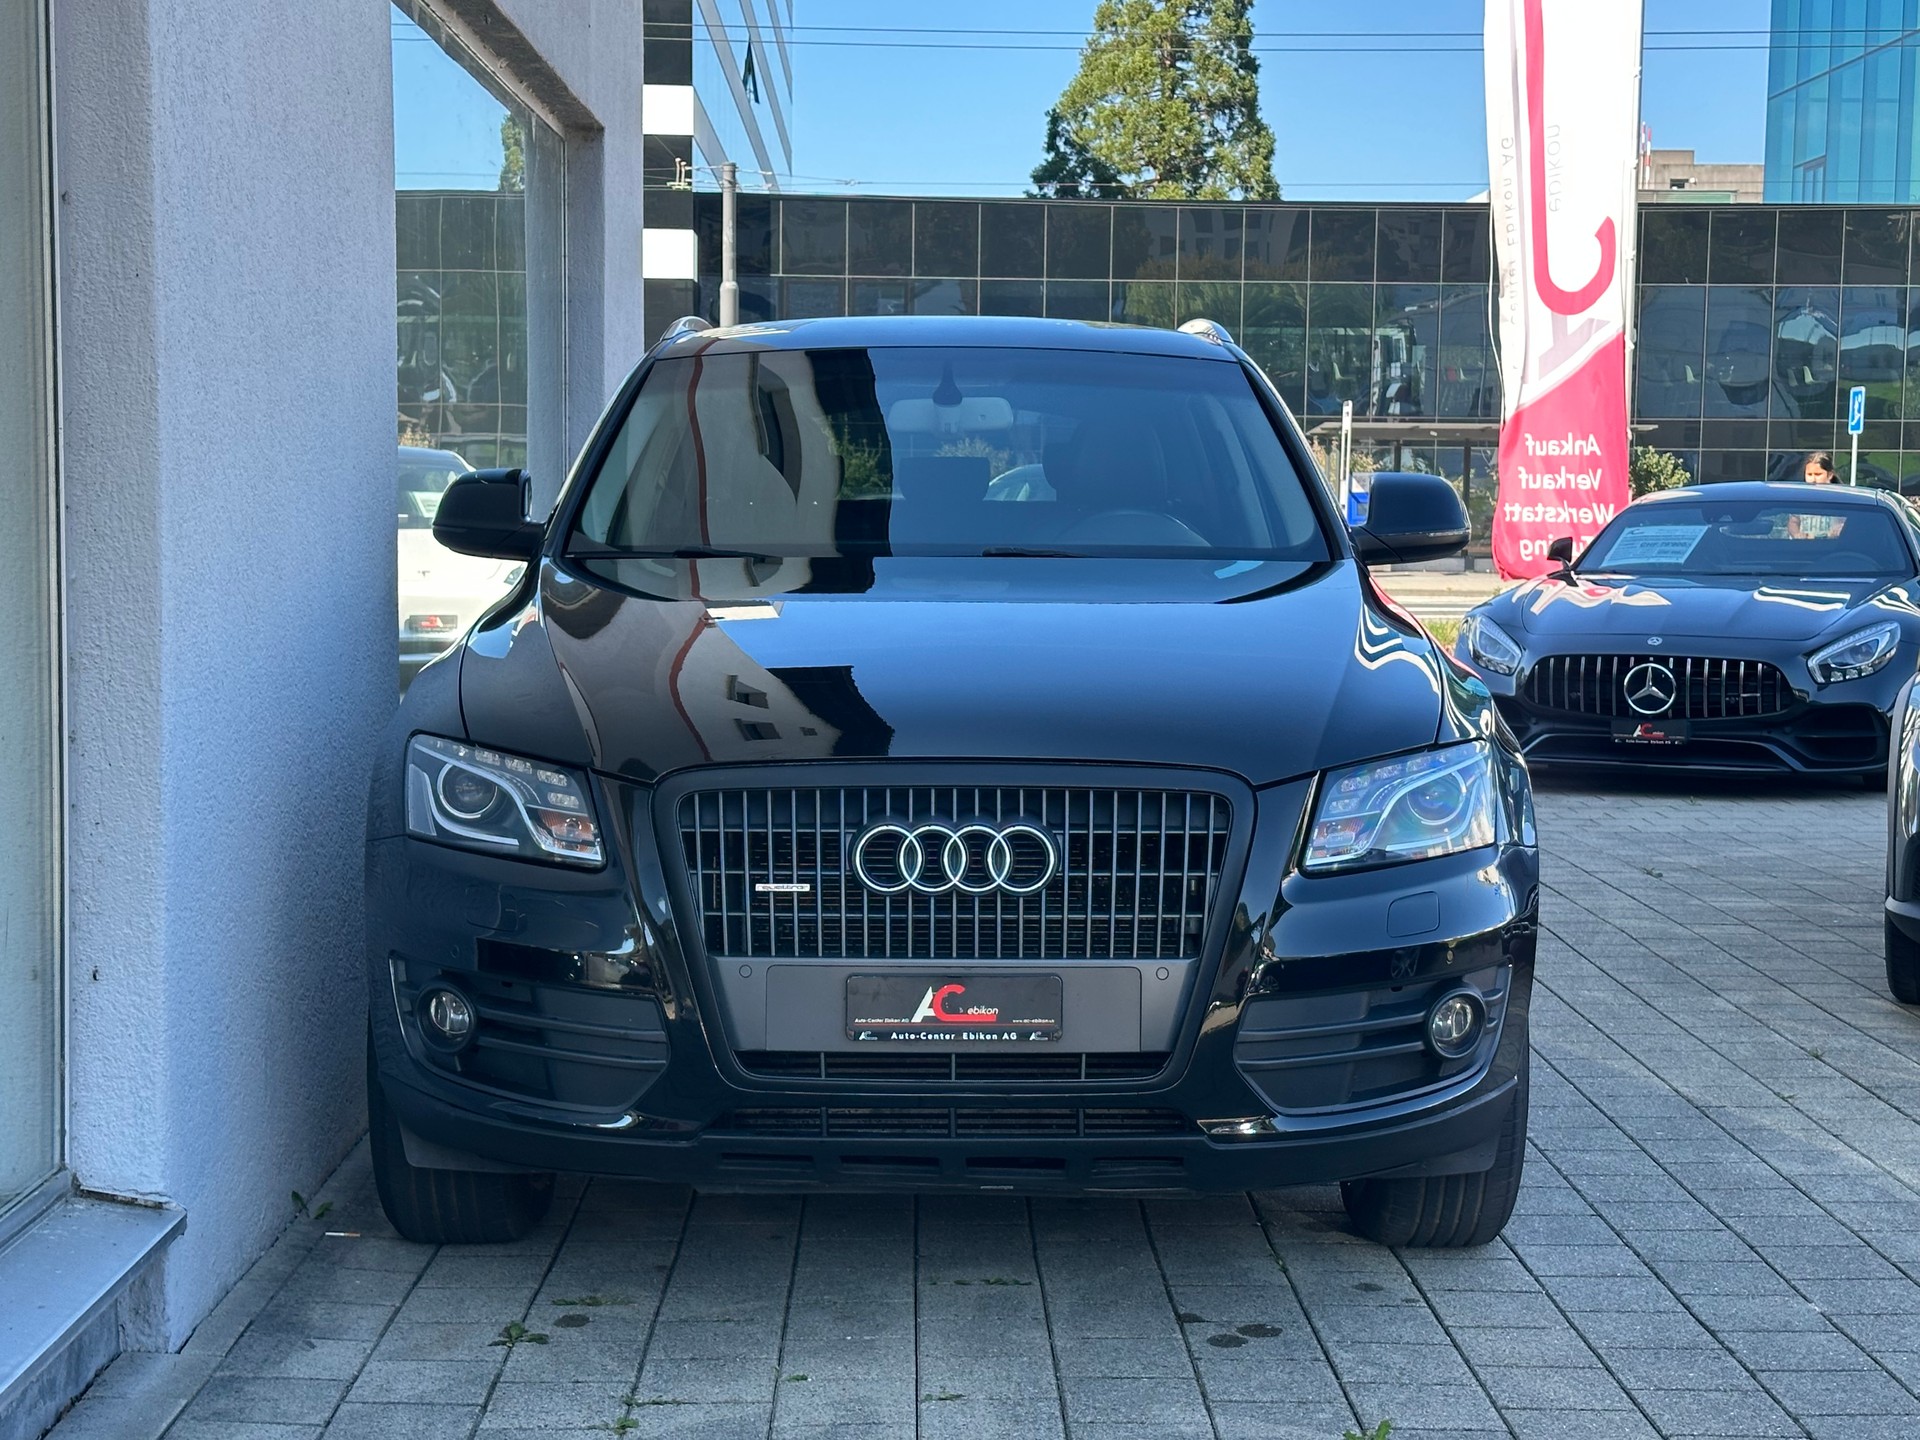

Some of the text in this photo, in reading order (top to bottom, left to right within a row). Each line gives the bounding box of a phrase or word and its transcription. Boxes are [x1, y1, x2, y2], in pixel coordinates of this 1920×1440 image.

[911, 984, 997, 1022] AC
[967, 1006, 999, 1015] ebikon
[891, 1032, 1017, 1040] Auto-Center Ebikon AG
